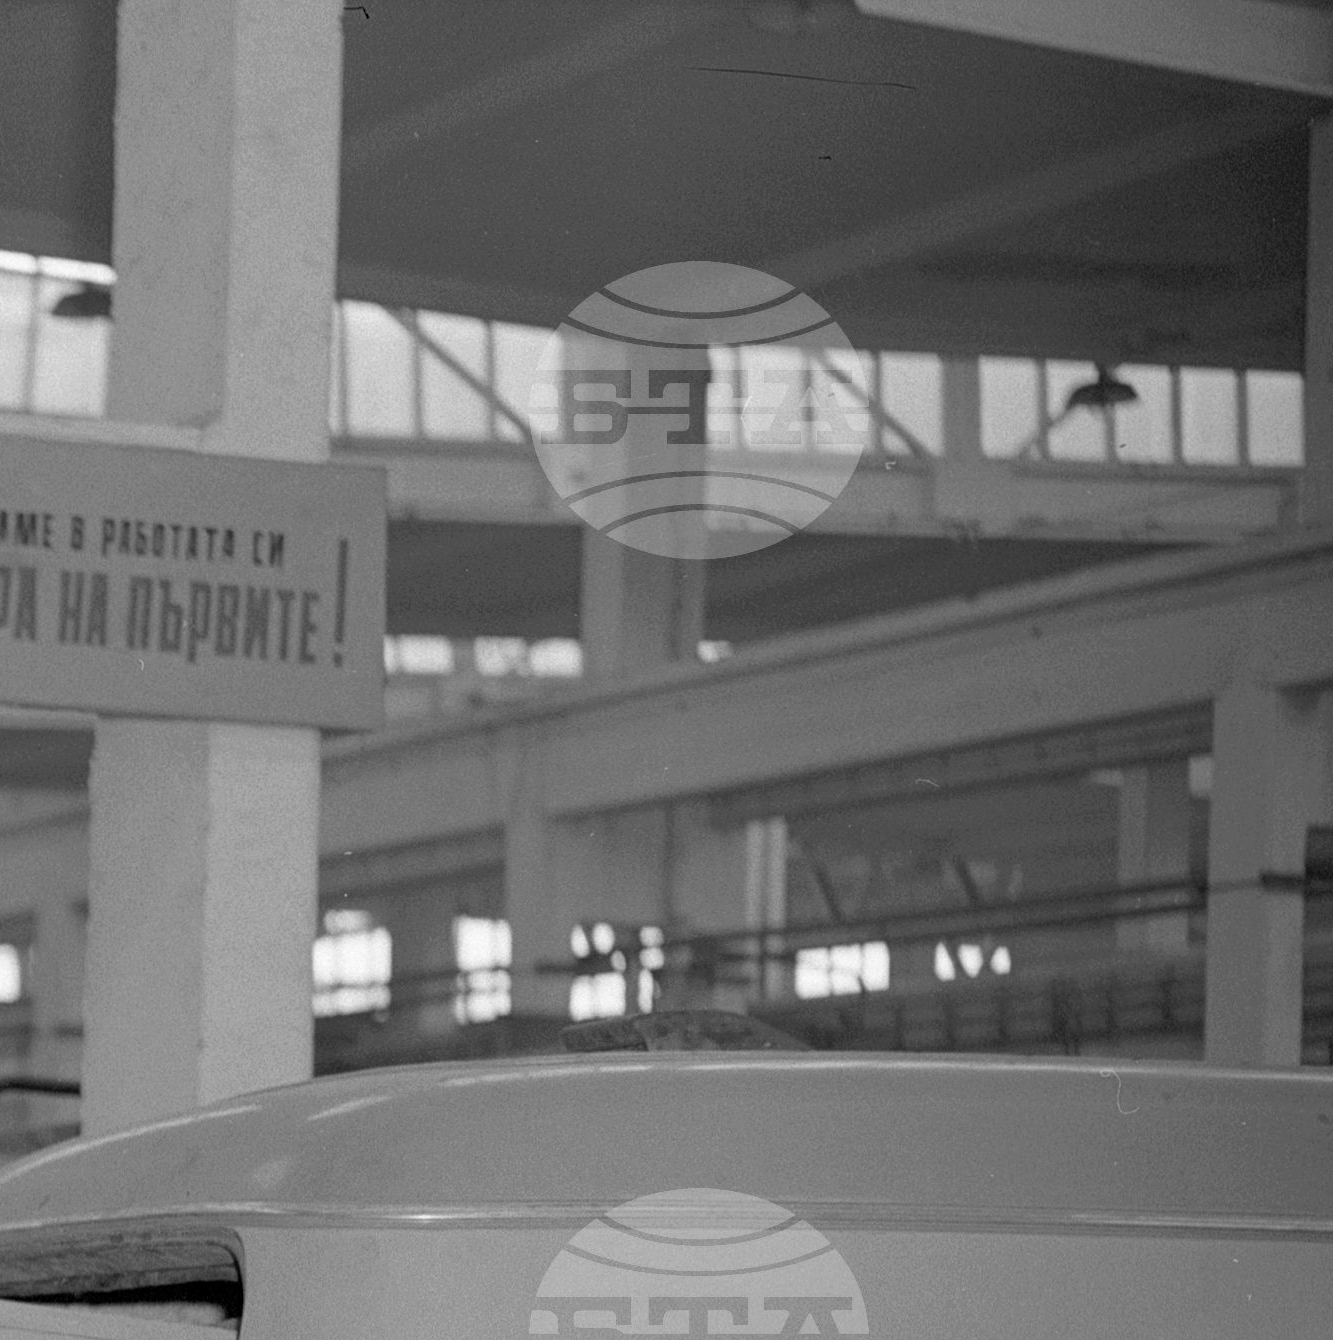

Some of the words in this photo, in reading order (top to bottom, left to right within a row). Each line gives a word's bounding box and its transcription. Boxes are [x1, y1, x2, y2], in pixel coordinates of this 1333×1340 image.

[70, 515, 85, 551] В
[101, 515, 236, 563] РАБОТАТА
[252, 530, 286, 569] СИ
[59, 569, 109, 647] НА
[128, 537, 349, 668] ПЪРВИТЕ!
